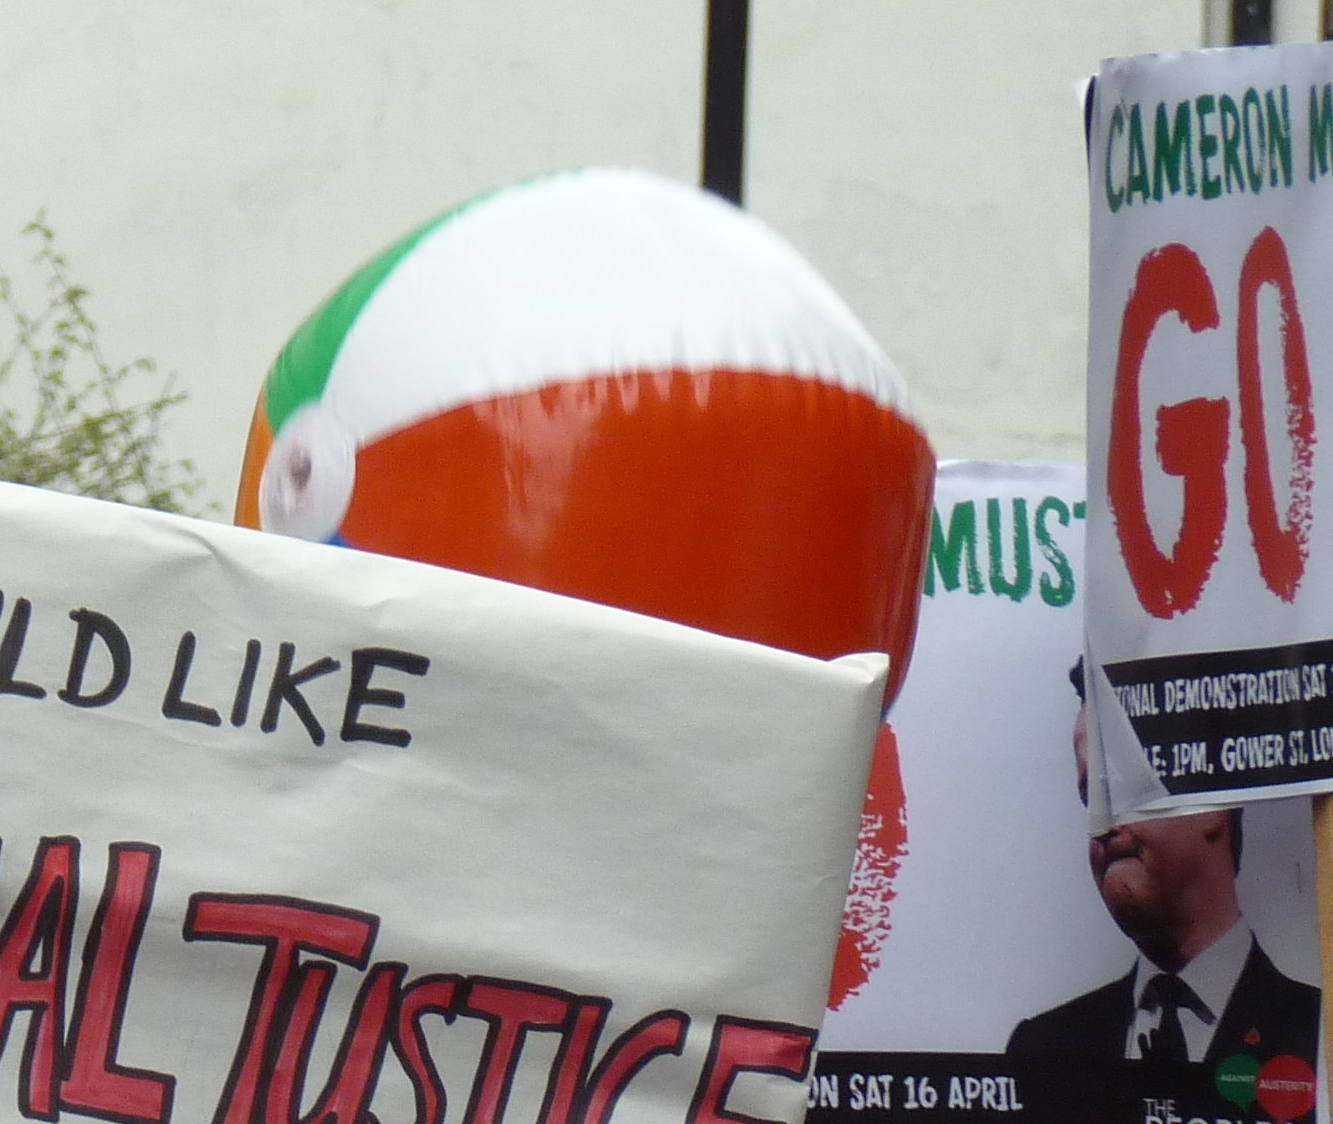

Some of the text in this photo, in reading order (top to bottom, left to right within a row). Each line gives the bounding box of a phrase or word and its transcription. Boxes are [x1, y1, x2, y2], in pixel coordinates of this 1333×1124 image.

[1106, 84, 1293, 214] CAMERON
[1105, 224, 1318, 620] GO
[161, 630, 431, 748] LIKE
[1163, 667, 1301, 713] DEMONSTRATION
[1302, 663, 1327, 702] SAT
[1220, 734, 1284, 772] GOWER
[849, 1073, 893, 1111] SAT
[903, 1075, 938, 1110] 16
[948, 1076, 1023, 1112] APRIL
[1143, 1097, 1177, 1118] THE
